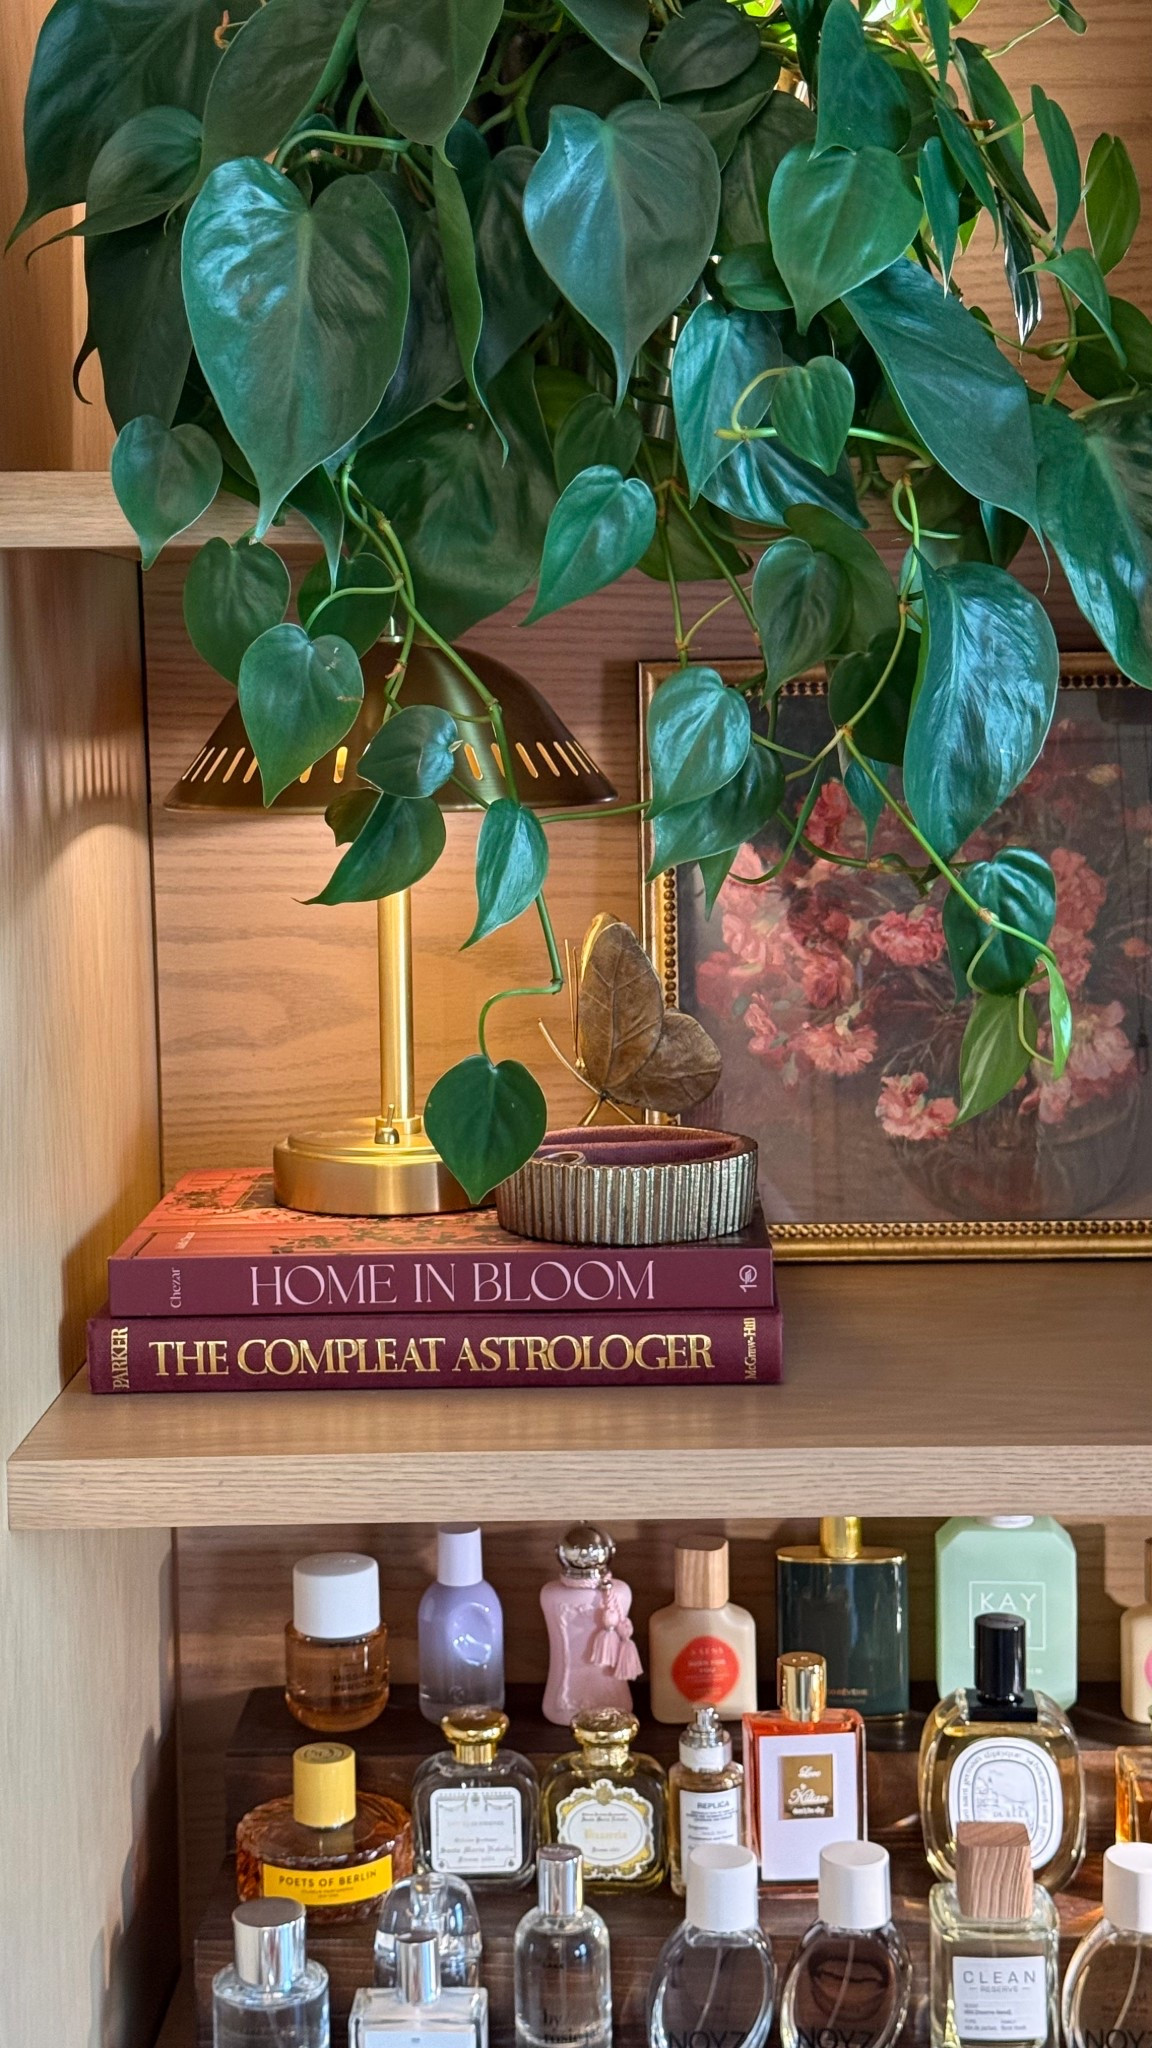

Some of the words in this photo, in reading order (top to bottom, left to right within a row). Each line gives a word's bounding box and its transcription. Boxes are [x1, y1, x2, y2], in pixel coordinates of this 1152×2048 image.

[170, 1267, 182, 1309] Chezar
[250, 1264, 398, 1306] HOME
[414, 1262, 455, 1304] IN
[473, 1260, 655, 1303] BLOOM
[111, 1327, 130, 1390] PARKER
[149, 1340, 230, 1377] THE
[237, 1337, 445, 1375] COMPLEAT
[452, 1334, 716, 1373] ASTROLOGER
[743, 1317, 757, 1380] McGraw-Hill
[980, 1592, 1037, 1612] KAY
[696, 1800, 730, 1809] REPLICA
[279, 1875, 315, 1888] POETS
[318, 1878, 334, 1888] OF
[338, 1869, 377, 1886] BERLIN
[963, 1970, 1036, 1984] CLEAN
[980, 1985, 1019, 1993] RESERVE
[1086, 2029, 1152, 2048] NOY
